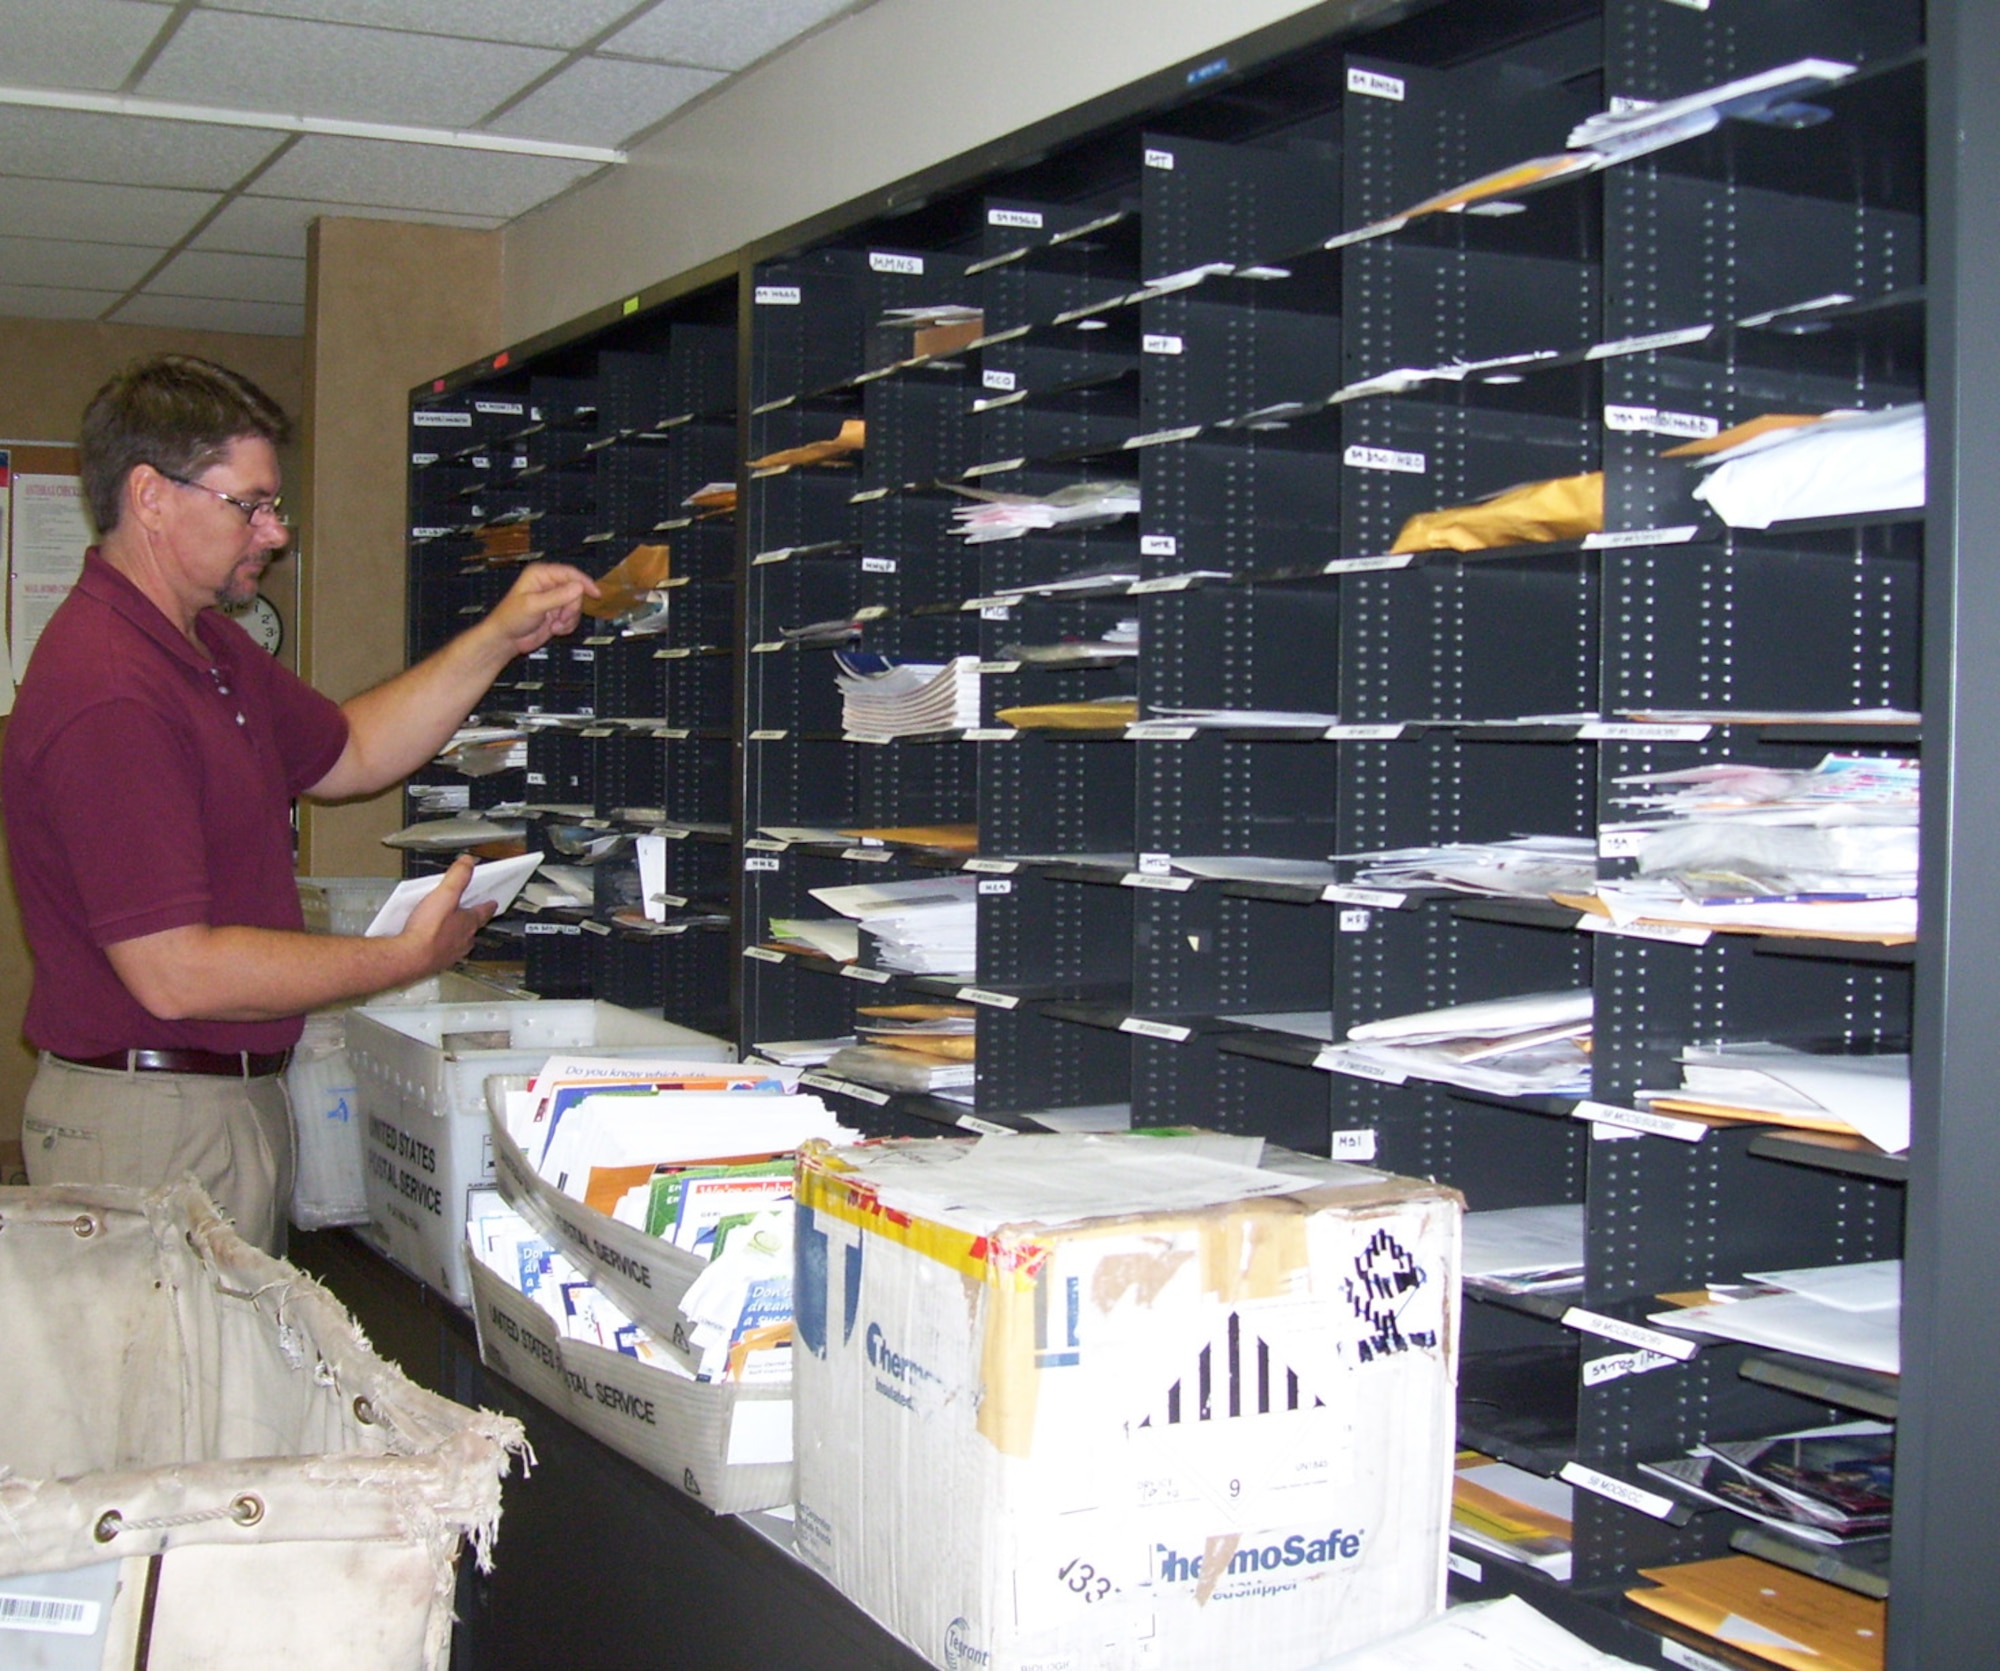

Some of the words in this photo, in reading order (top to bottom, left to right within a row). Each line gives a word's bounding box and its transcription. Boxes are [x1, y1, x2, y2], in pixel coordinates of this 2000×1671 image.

[262, 614, 270, 625] 2
[265, 628, 274, 637] 3
[566, 1066, 583, 1075] Do
[586, 1067, 609, 1078] you
[610, 1067, 643, 1079] know
[398, 1131, 436, 1175] STATES
[400, 1170, 441, 1216] SERVICE
[594, 1238, 652, 1289] SERVICE
[743, 1316, 753, 1326] a
[488, 1303, 519, 1342] UNITED
[521, 1329, 556, 1370] STATES
[594, 1383, 656, 1425] SERVICE
[1230, 1479, 1241, 1497] 9
[948, 1629, 990, 1667] Tegrant
